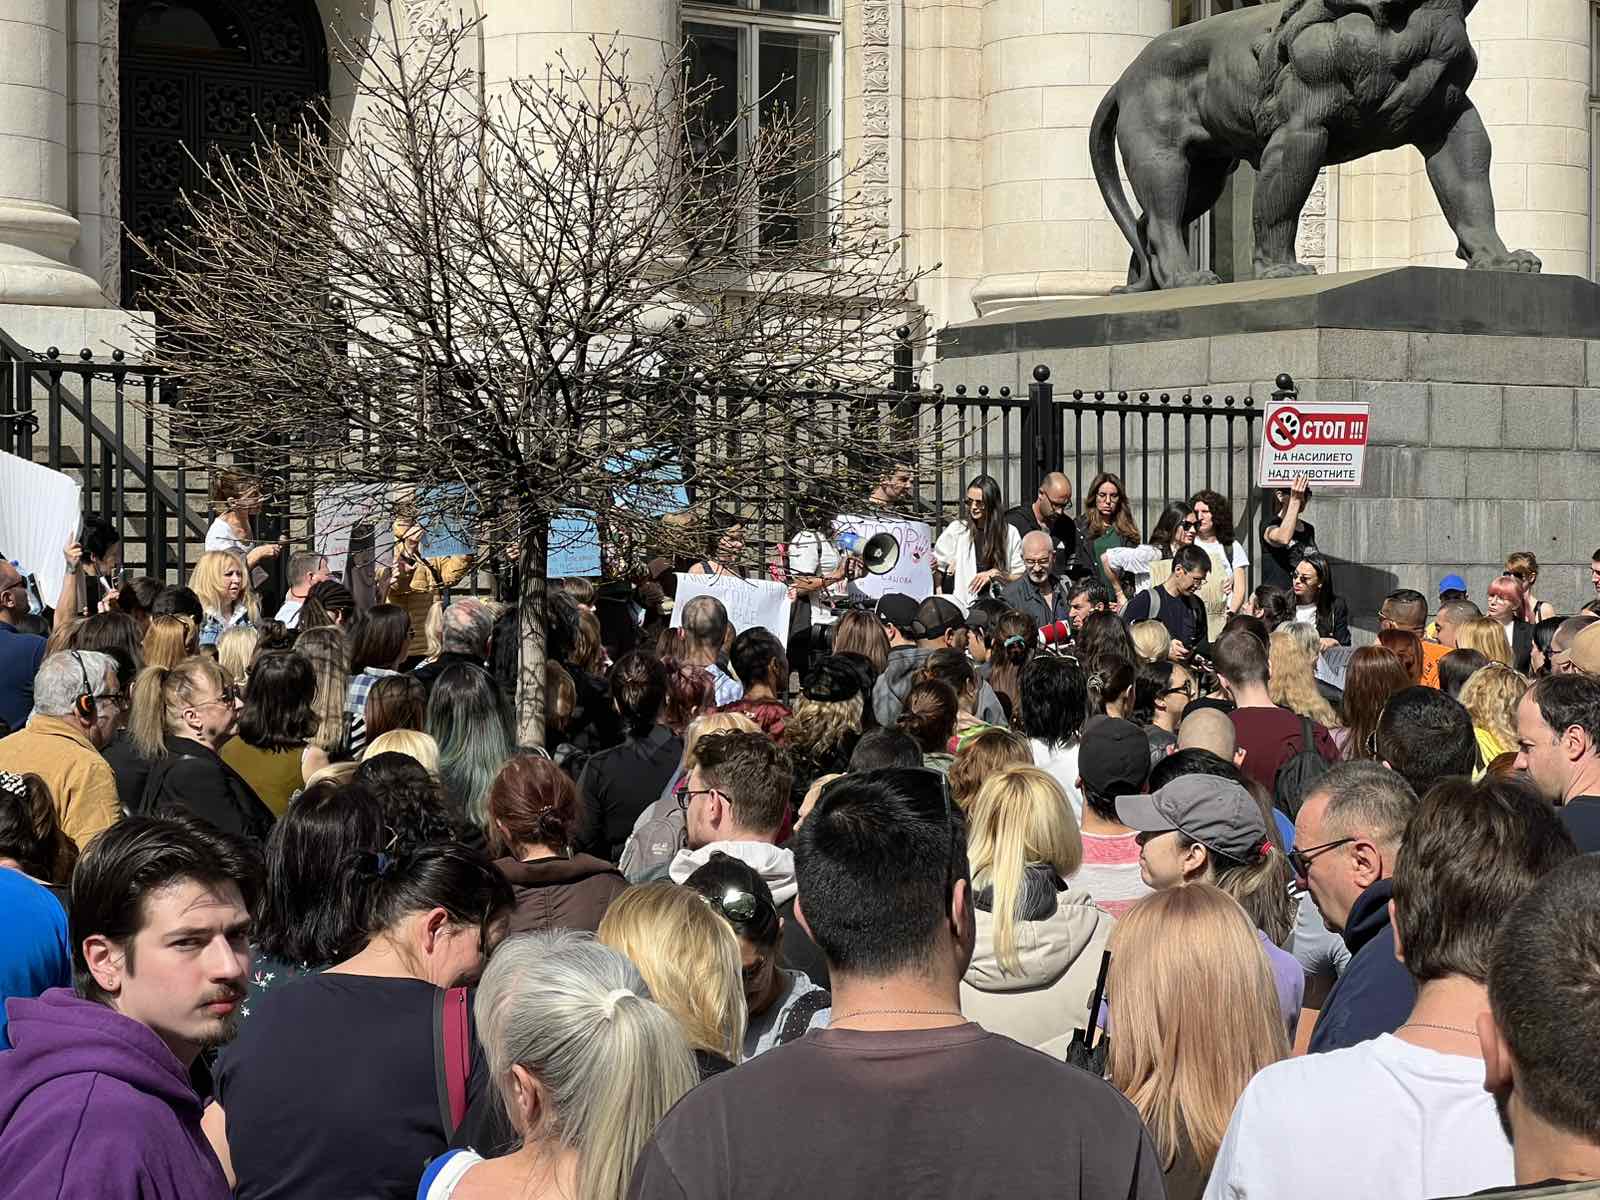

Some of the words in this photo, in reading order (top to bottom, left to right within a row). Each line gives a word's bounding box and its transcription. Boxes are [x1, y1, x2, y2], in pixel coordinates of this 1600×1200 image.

[1302, 421, 1346, 440] СТОП
[1350, 421, 1364, 440] !!!
[1274, 453, 1288, 462] НА
[1290, 453, 1353, 462] НАСИЛИЕТО
[1268, 469, 1290, 480] НАД
